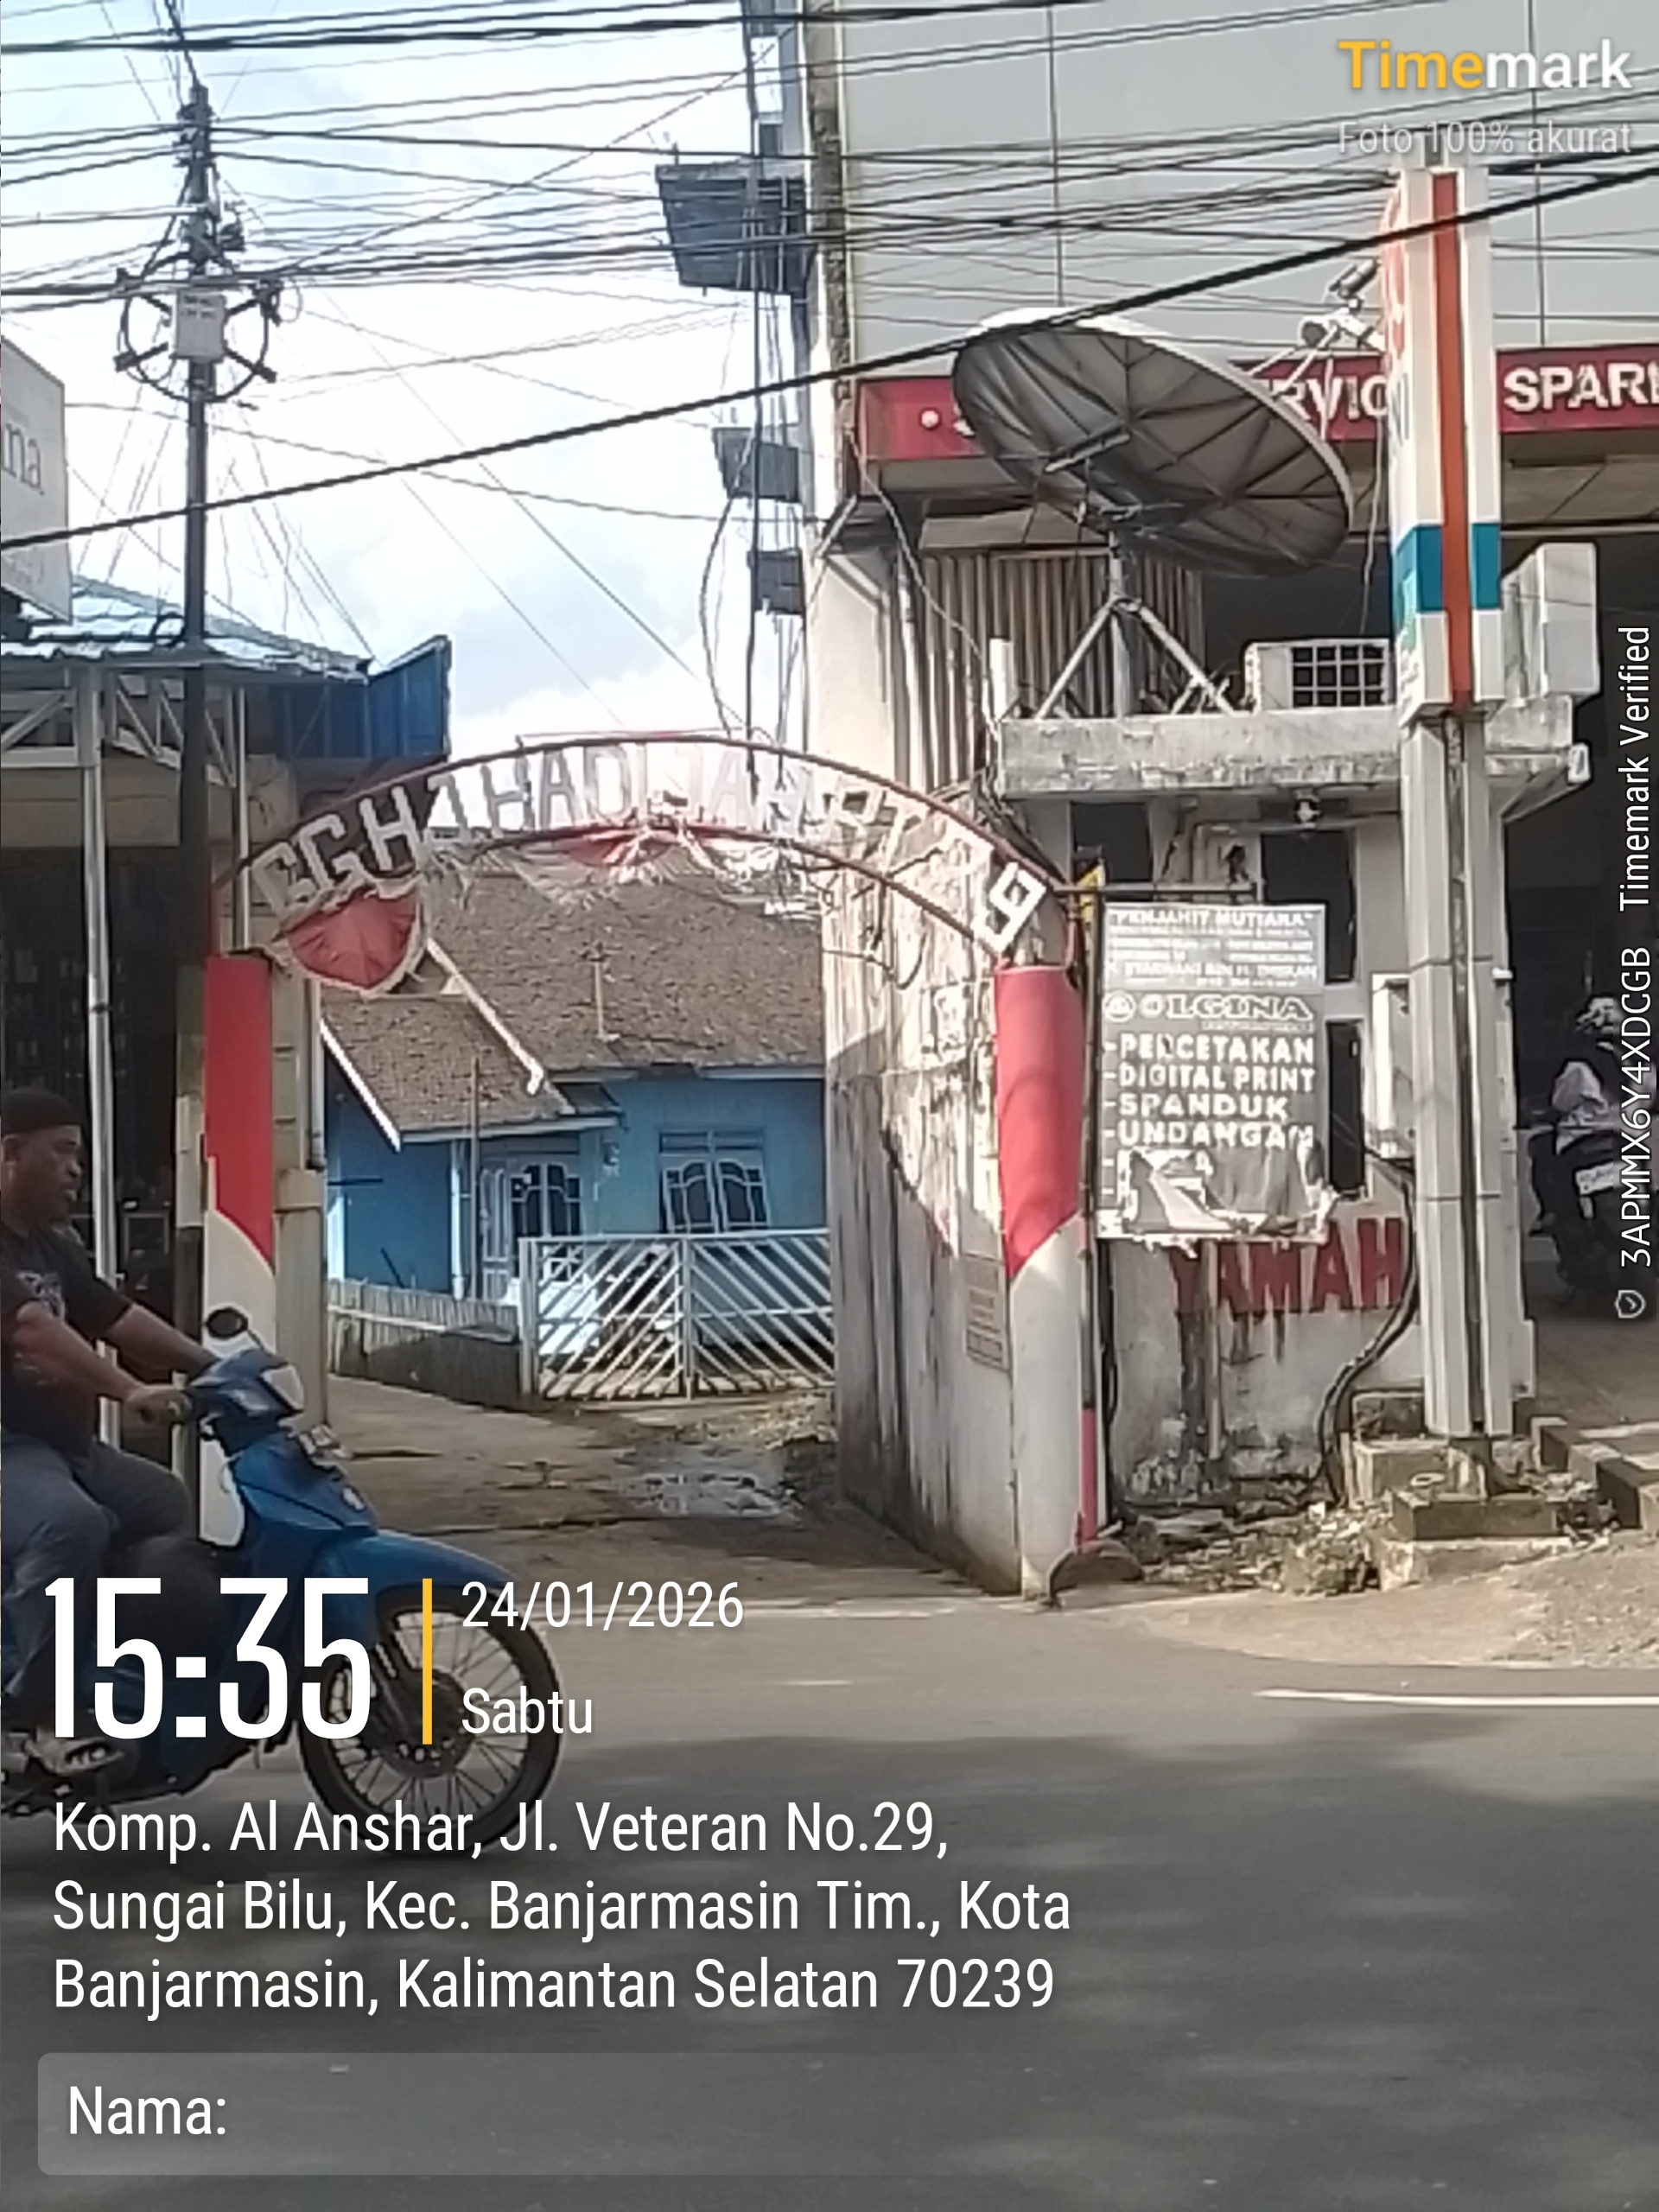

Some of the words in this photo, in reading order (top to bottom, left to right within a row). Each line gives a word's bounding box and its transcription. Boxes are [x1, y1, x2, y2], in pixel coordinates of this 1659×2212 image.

[1118, 1062, 1228, 1090] DIGITAL
[1233, 1065, 1316, 1092] PRINT
[1118, 1092, 1289, 1120] SPANDUK
[1168, 1217, 1402, 1320] YAMAH
